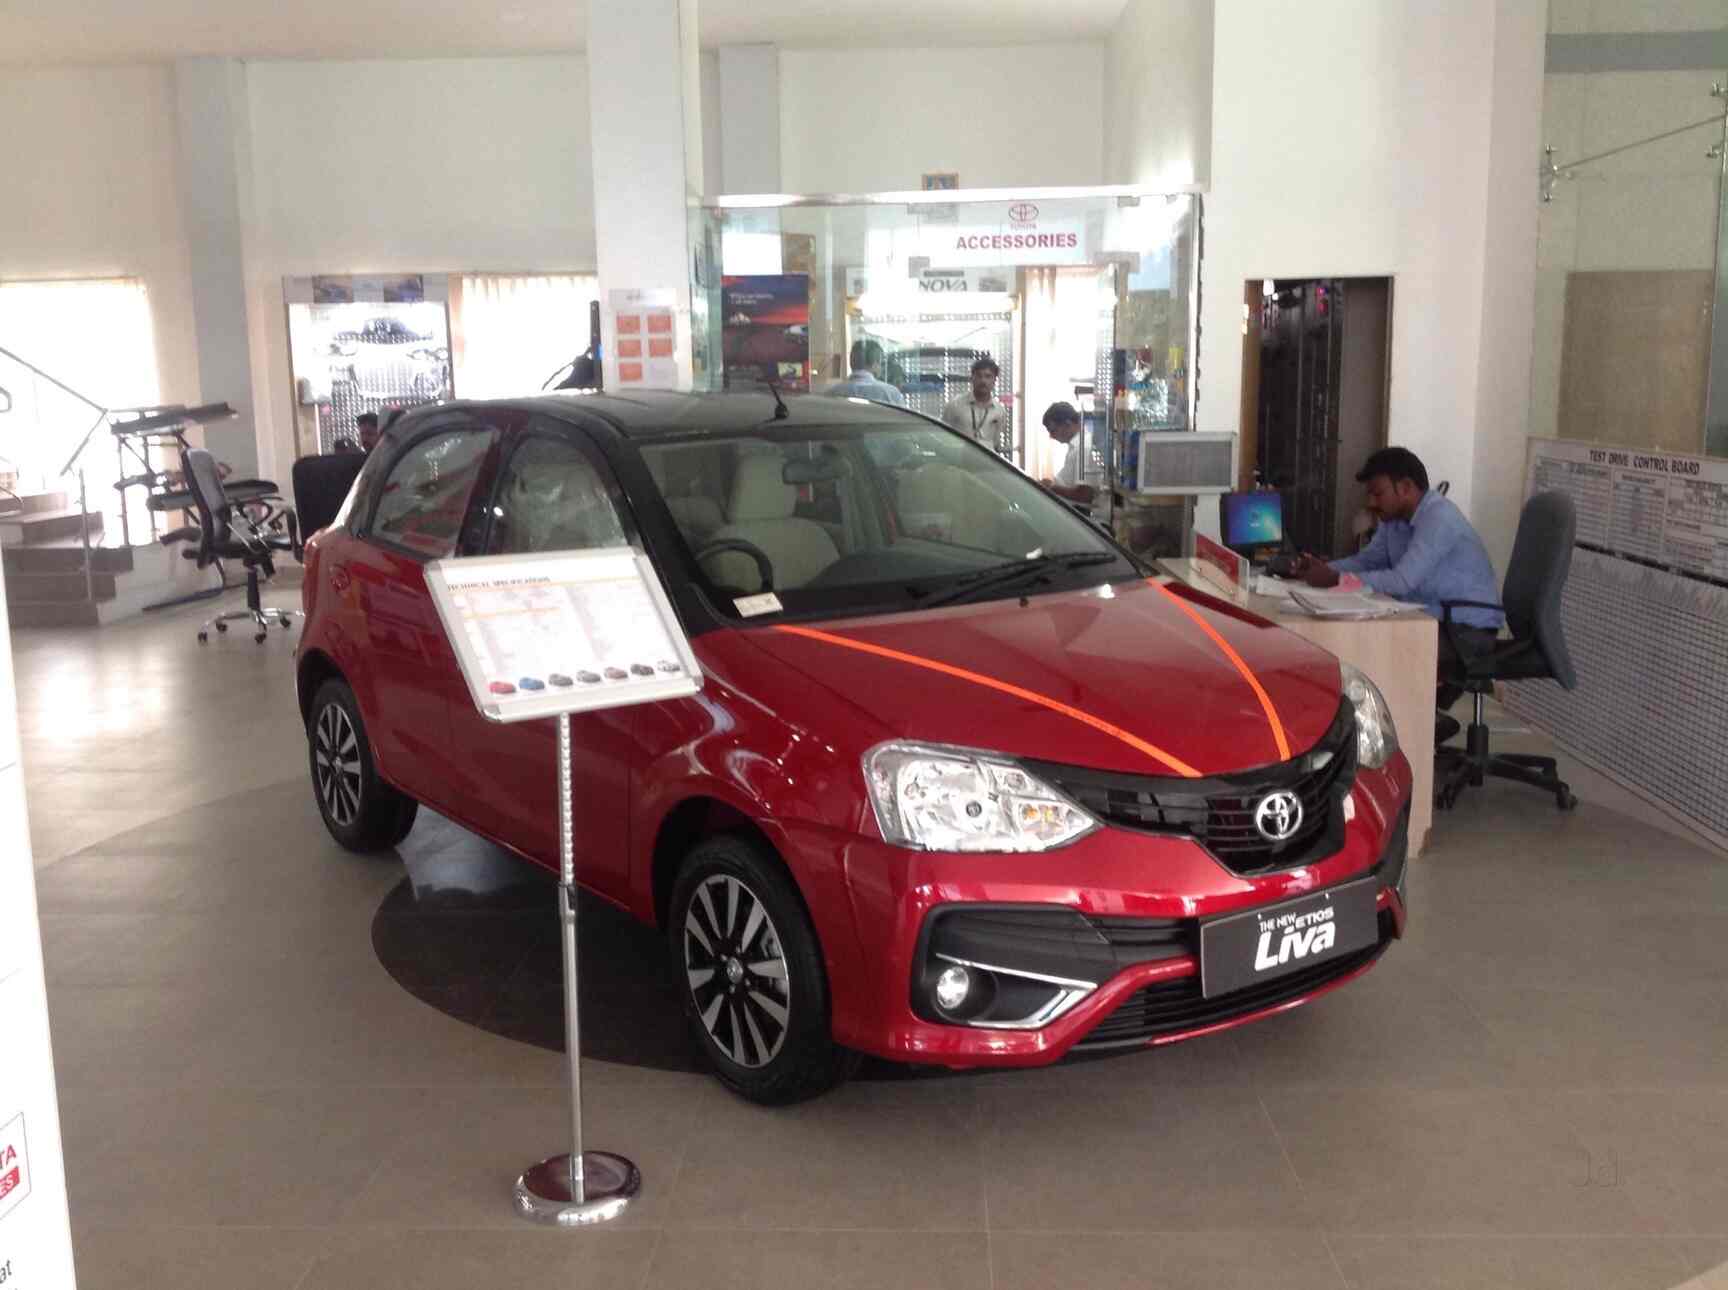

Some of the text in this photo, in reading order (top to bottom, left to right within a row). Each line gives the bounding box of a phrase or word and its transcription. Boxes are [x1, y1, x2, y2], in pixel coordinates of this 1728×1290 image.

[956, 233, 1078, 249] ACCESSORIES
[1590, 450, 1700, 475] TEST DRIVE CONTROL BOARD
[1260, 907, 1334, 932] THE NEW ETIOS
[1255, 921, 1335, 971] Liva
